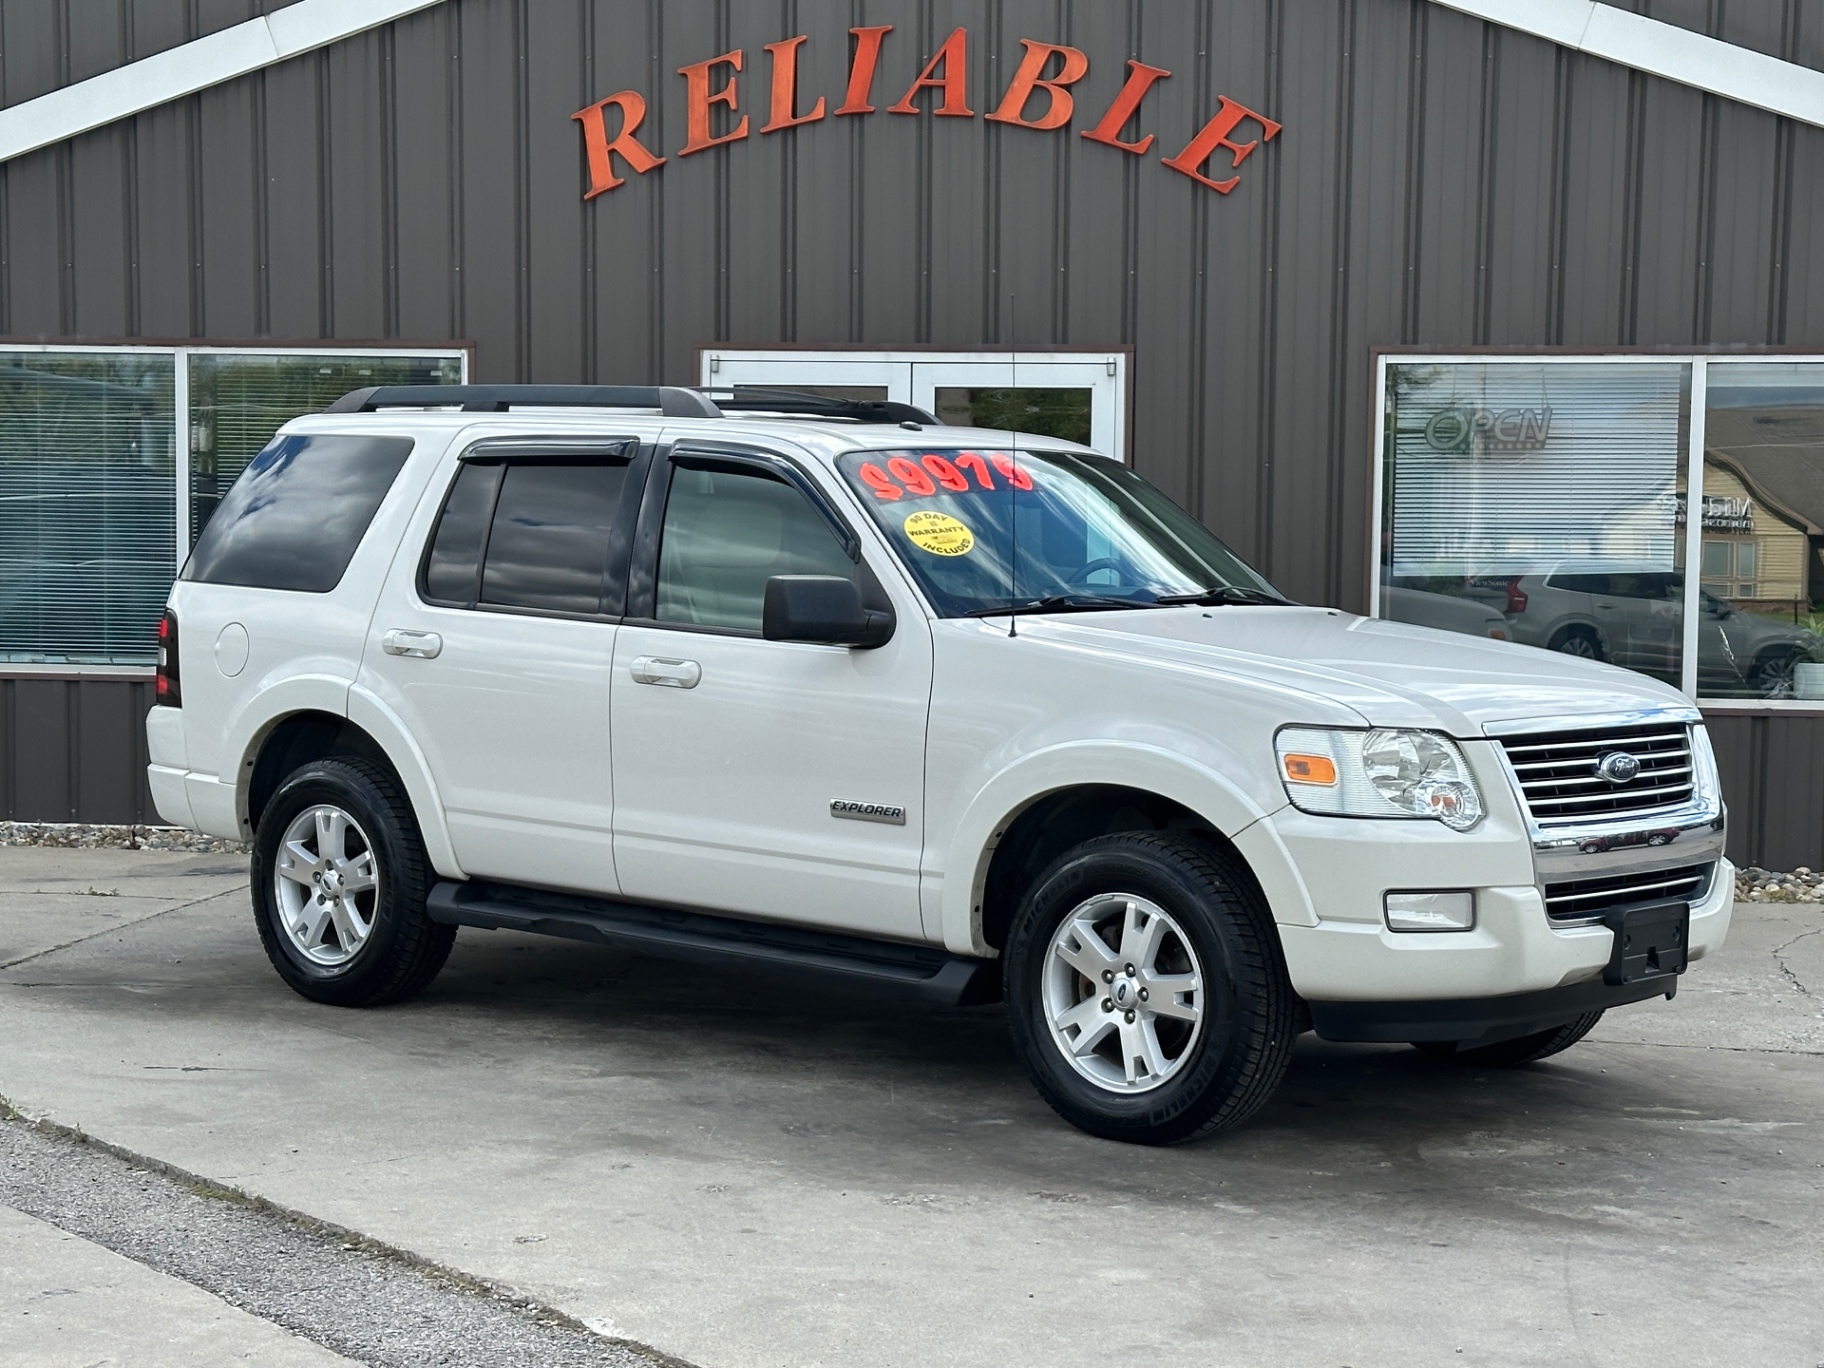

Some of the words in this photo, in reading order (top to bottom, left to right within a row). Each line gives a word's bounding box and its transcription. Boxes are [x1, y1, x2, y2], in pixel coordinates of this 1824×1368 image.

[570, 24, 1282, 201] RELIABLE
[1424, 406, 1553, 450] OPEN
[907, 525, 964, 536] WARRANTY
[910, 514, 923, 524] 90
[923, 513, 948, 521] DAY
[922, 538, 971, 554] INCLUDED
[832, 801, 902, 817] EXPLORER
[1023, 869, 1082, 937] MICHELIN
[1152, 1054, 1217, 1124] MICHELIN
